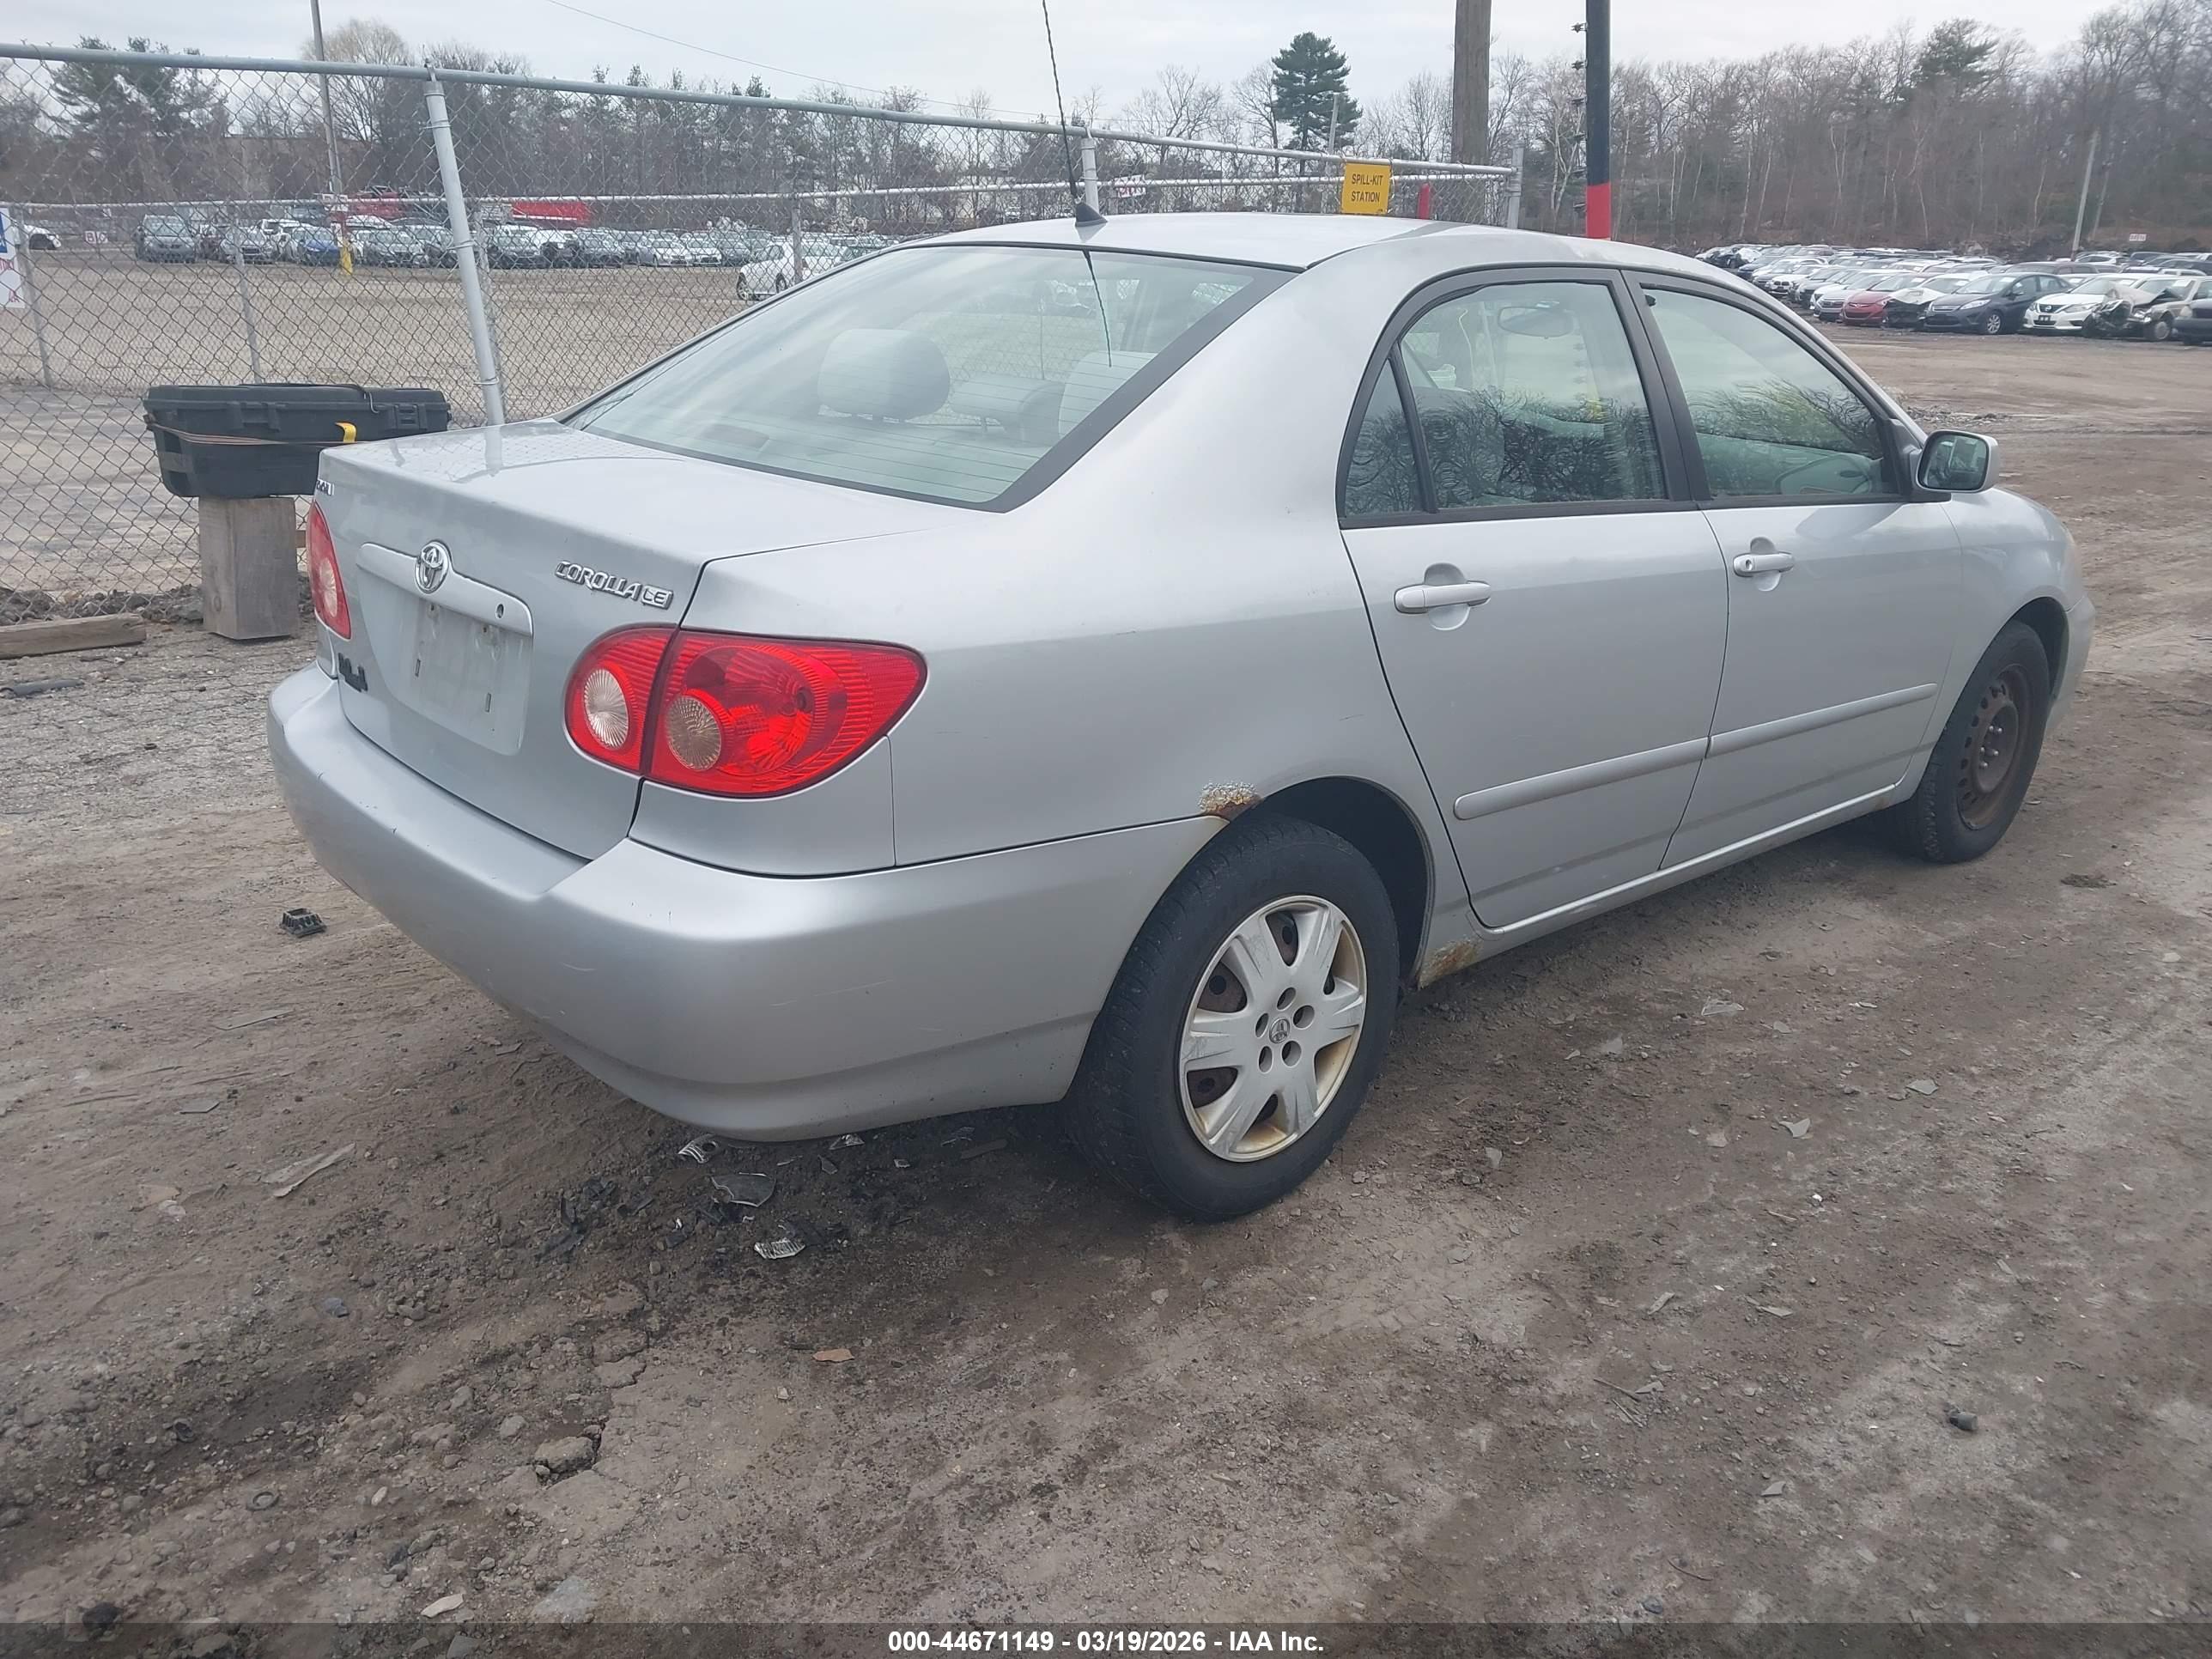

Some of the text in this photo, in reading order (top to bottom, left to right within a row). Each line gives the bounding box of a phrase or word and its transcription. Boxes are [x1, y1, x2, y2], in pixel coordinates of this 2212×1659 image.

[1352, 173, 1383, 185] SPILL-KIT
[1351, 191, 1380, 203] STATION
[555, 560, 672, 609] COROLLA LE
